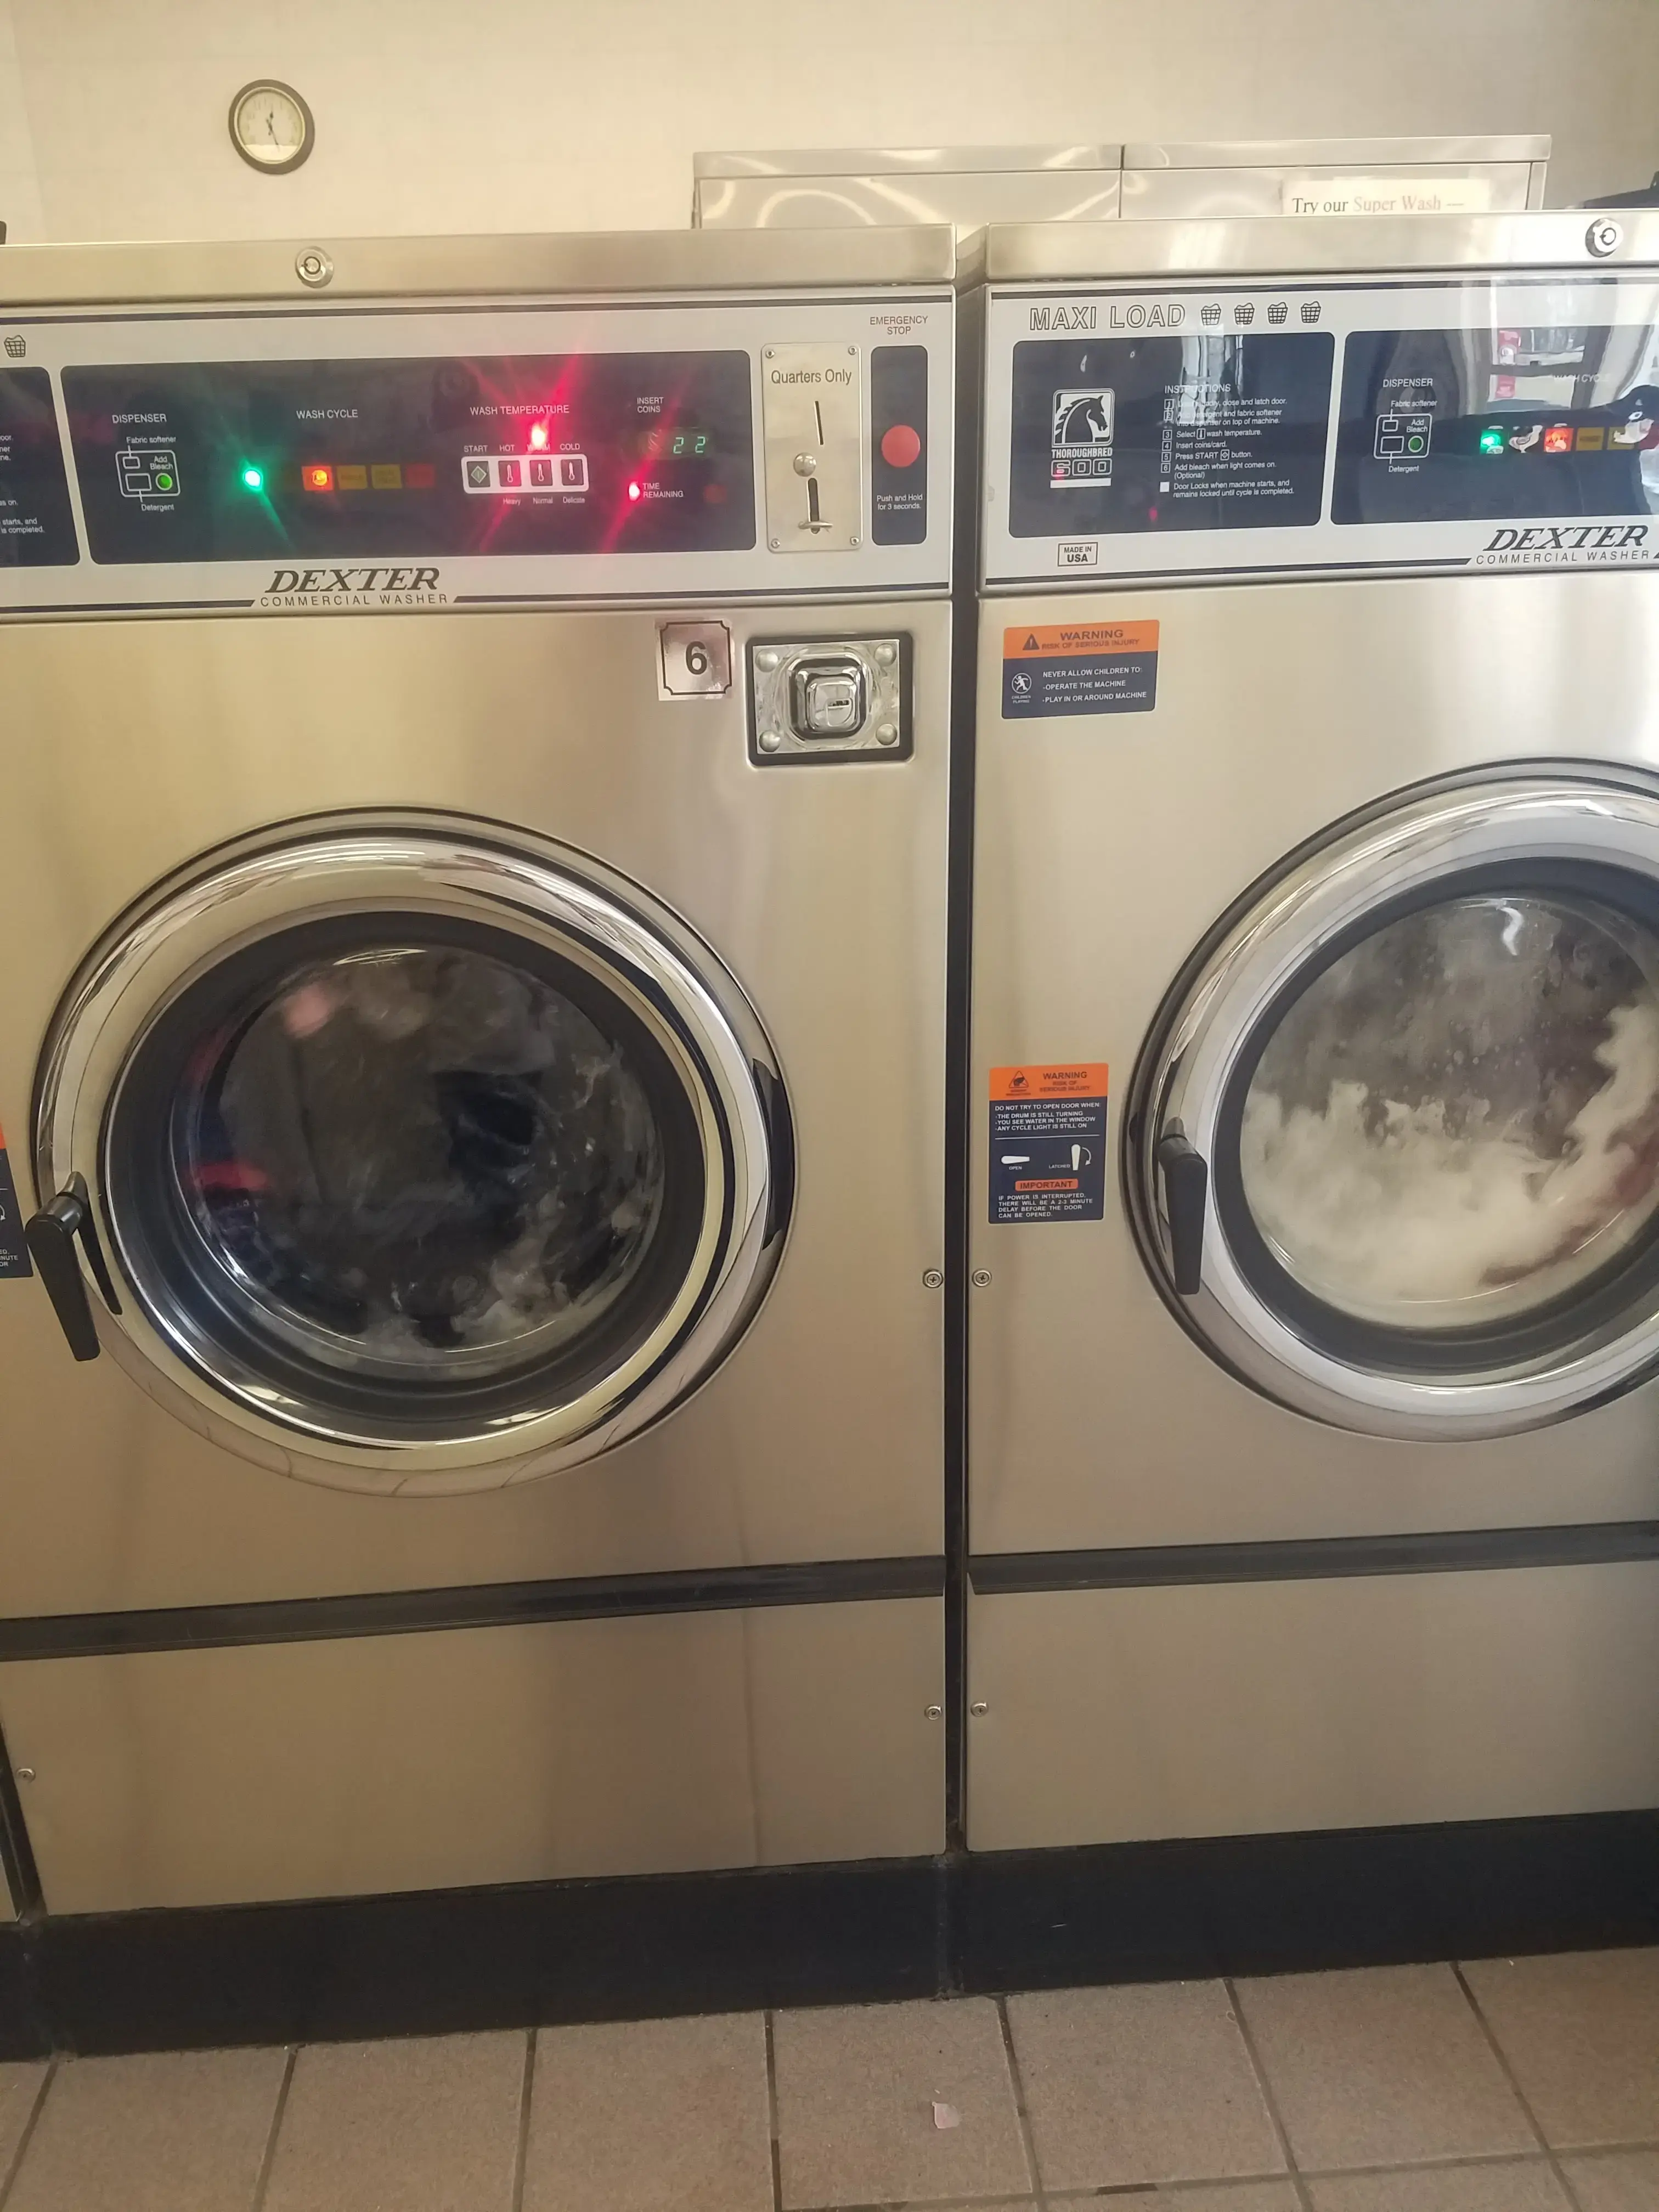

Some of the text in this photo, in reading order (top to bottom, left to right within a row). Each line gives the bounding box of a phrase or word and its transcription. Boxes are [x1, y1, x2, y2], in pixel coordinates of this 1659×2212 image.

[1291, 194, 1441, 214] Try our Super Wash
[870, 315, 928, 325] EMERGENCY
[1030, 304, 1185, 330] MAXI LOAD
[887, 326, 911, 335] STOP
[771, 369, 851, 386] Quarters Only
[1383, 378, 1433, 388] DISPENSER
[296, 409, 358, 419] WASH CYCLE
[470, 405, 569, 416] WASH TEMPERATURE
[112, 413, 167, 424] DISPENSER
[1224, 429, 1262, 437] temperature.
[1051, 447, 1113, 459] THOROUGHBRED
[1051, 458, 1112, 477] 600
[1230, 462, 1243, 470] light
[1175, 472, 1205, 480] (Optional)
[1236, 488, 1252, 497] cycle
[1261, 487, 1294, 496] completed.
[877, 494, 893, 502] Push
[1482, 525, 1648, 551] DEXTER
[1067, 554, 1088, 563] USA
[1476, 550, 1649, 565] COMMERCIAL WASHER
[264, 567, 439, 593] DEXTER
[261, 594, 447, 607] COMMERCIAL WASHER
[1060, 629, 1123, 641] WARNING
[686, 641, 707, 675] 6
[1043, 1071, 1087, 1080] WARNING
[1020, 1181, 1073, 1189] IMPORTANT
